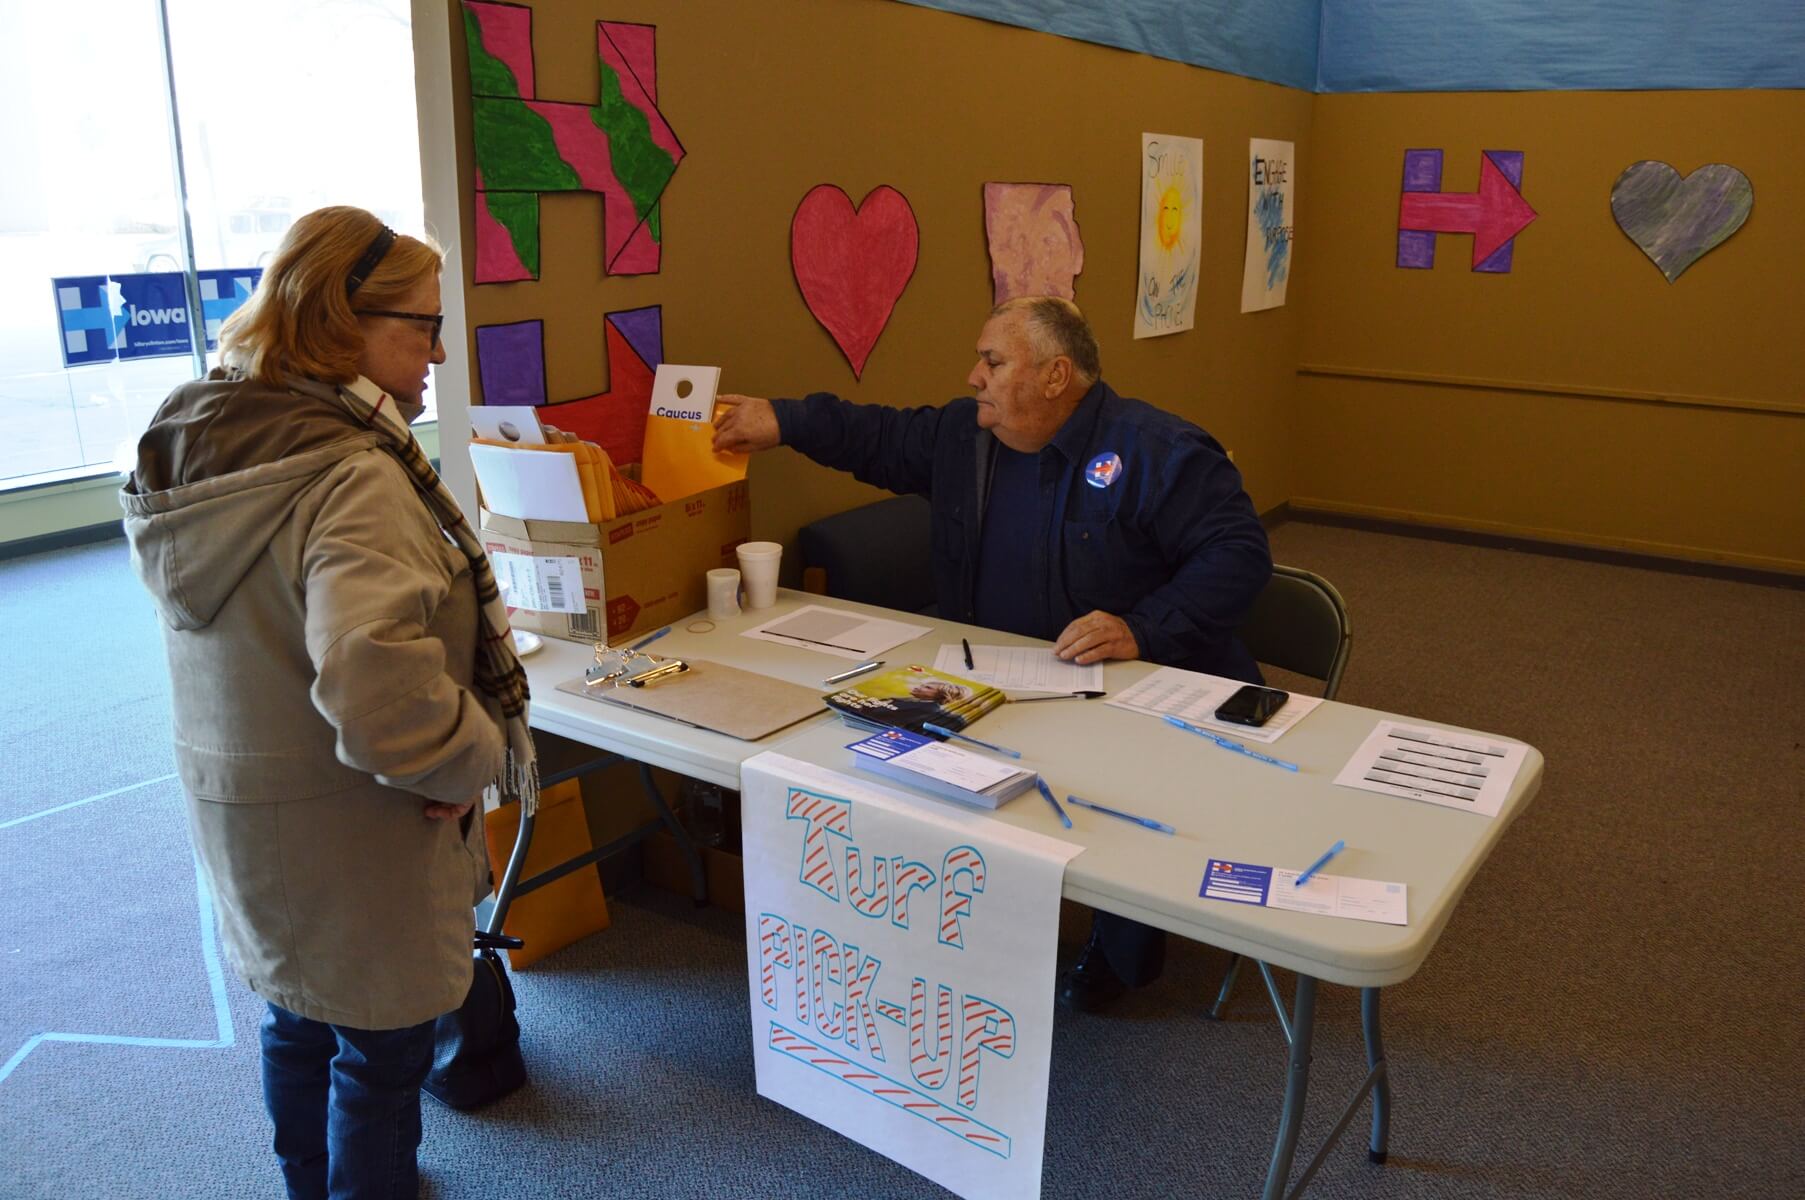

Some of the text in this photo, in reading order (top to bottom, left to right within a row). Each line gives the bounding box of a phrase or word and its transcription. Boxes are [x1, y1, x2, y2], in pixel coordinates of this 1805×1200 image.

[129, 304, 187, 327] Iowa
[656, 406, 703, 420] Caucus
[786, 787, 987, 949] Turf
[758, 913, 1017, 1111] PICK-UP
